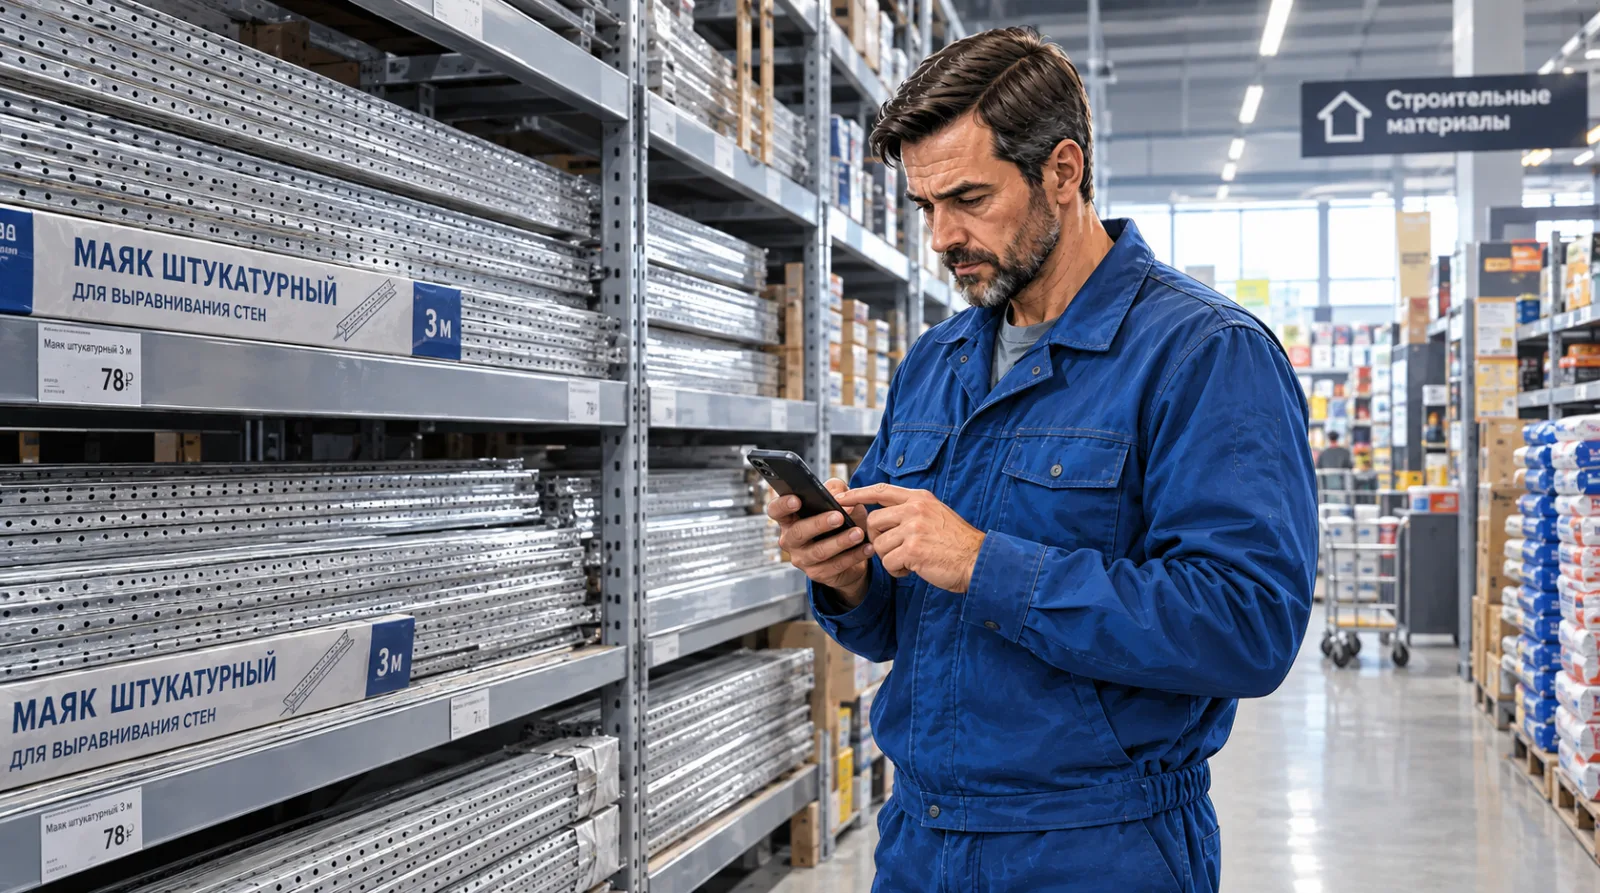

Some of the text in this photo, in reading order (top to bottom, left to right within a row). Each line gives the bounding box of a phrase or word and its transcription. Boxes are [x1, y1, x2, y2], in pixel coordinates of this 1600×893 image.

[1386, 88, 1552, 112] Строительные
[1386, 114, 1510, 136] материалы
[73, 236, 338, 306] МАЯК ШТУКАТУРНЫЙ
[72, 282, 267, 322] ДЛЯ ВЫРАВНИВАНИЯ СТЕН
[44, 338, 66, 350] Маяк
[67, 342, 118, 355] штукатурный
[12, 650, 277, 734] МАЯК ШТУКАТУРНЫЙ
[9, 707, 217, 772] ДЛЯ ВЫРАВНИВАНИЯ СТЕН
[45, 821, 68, 835] Маяк
[68, 804, 119, 827] штукатурный
